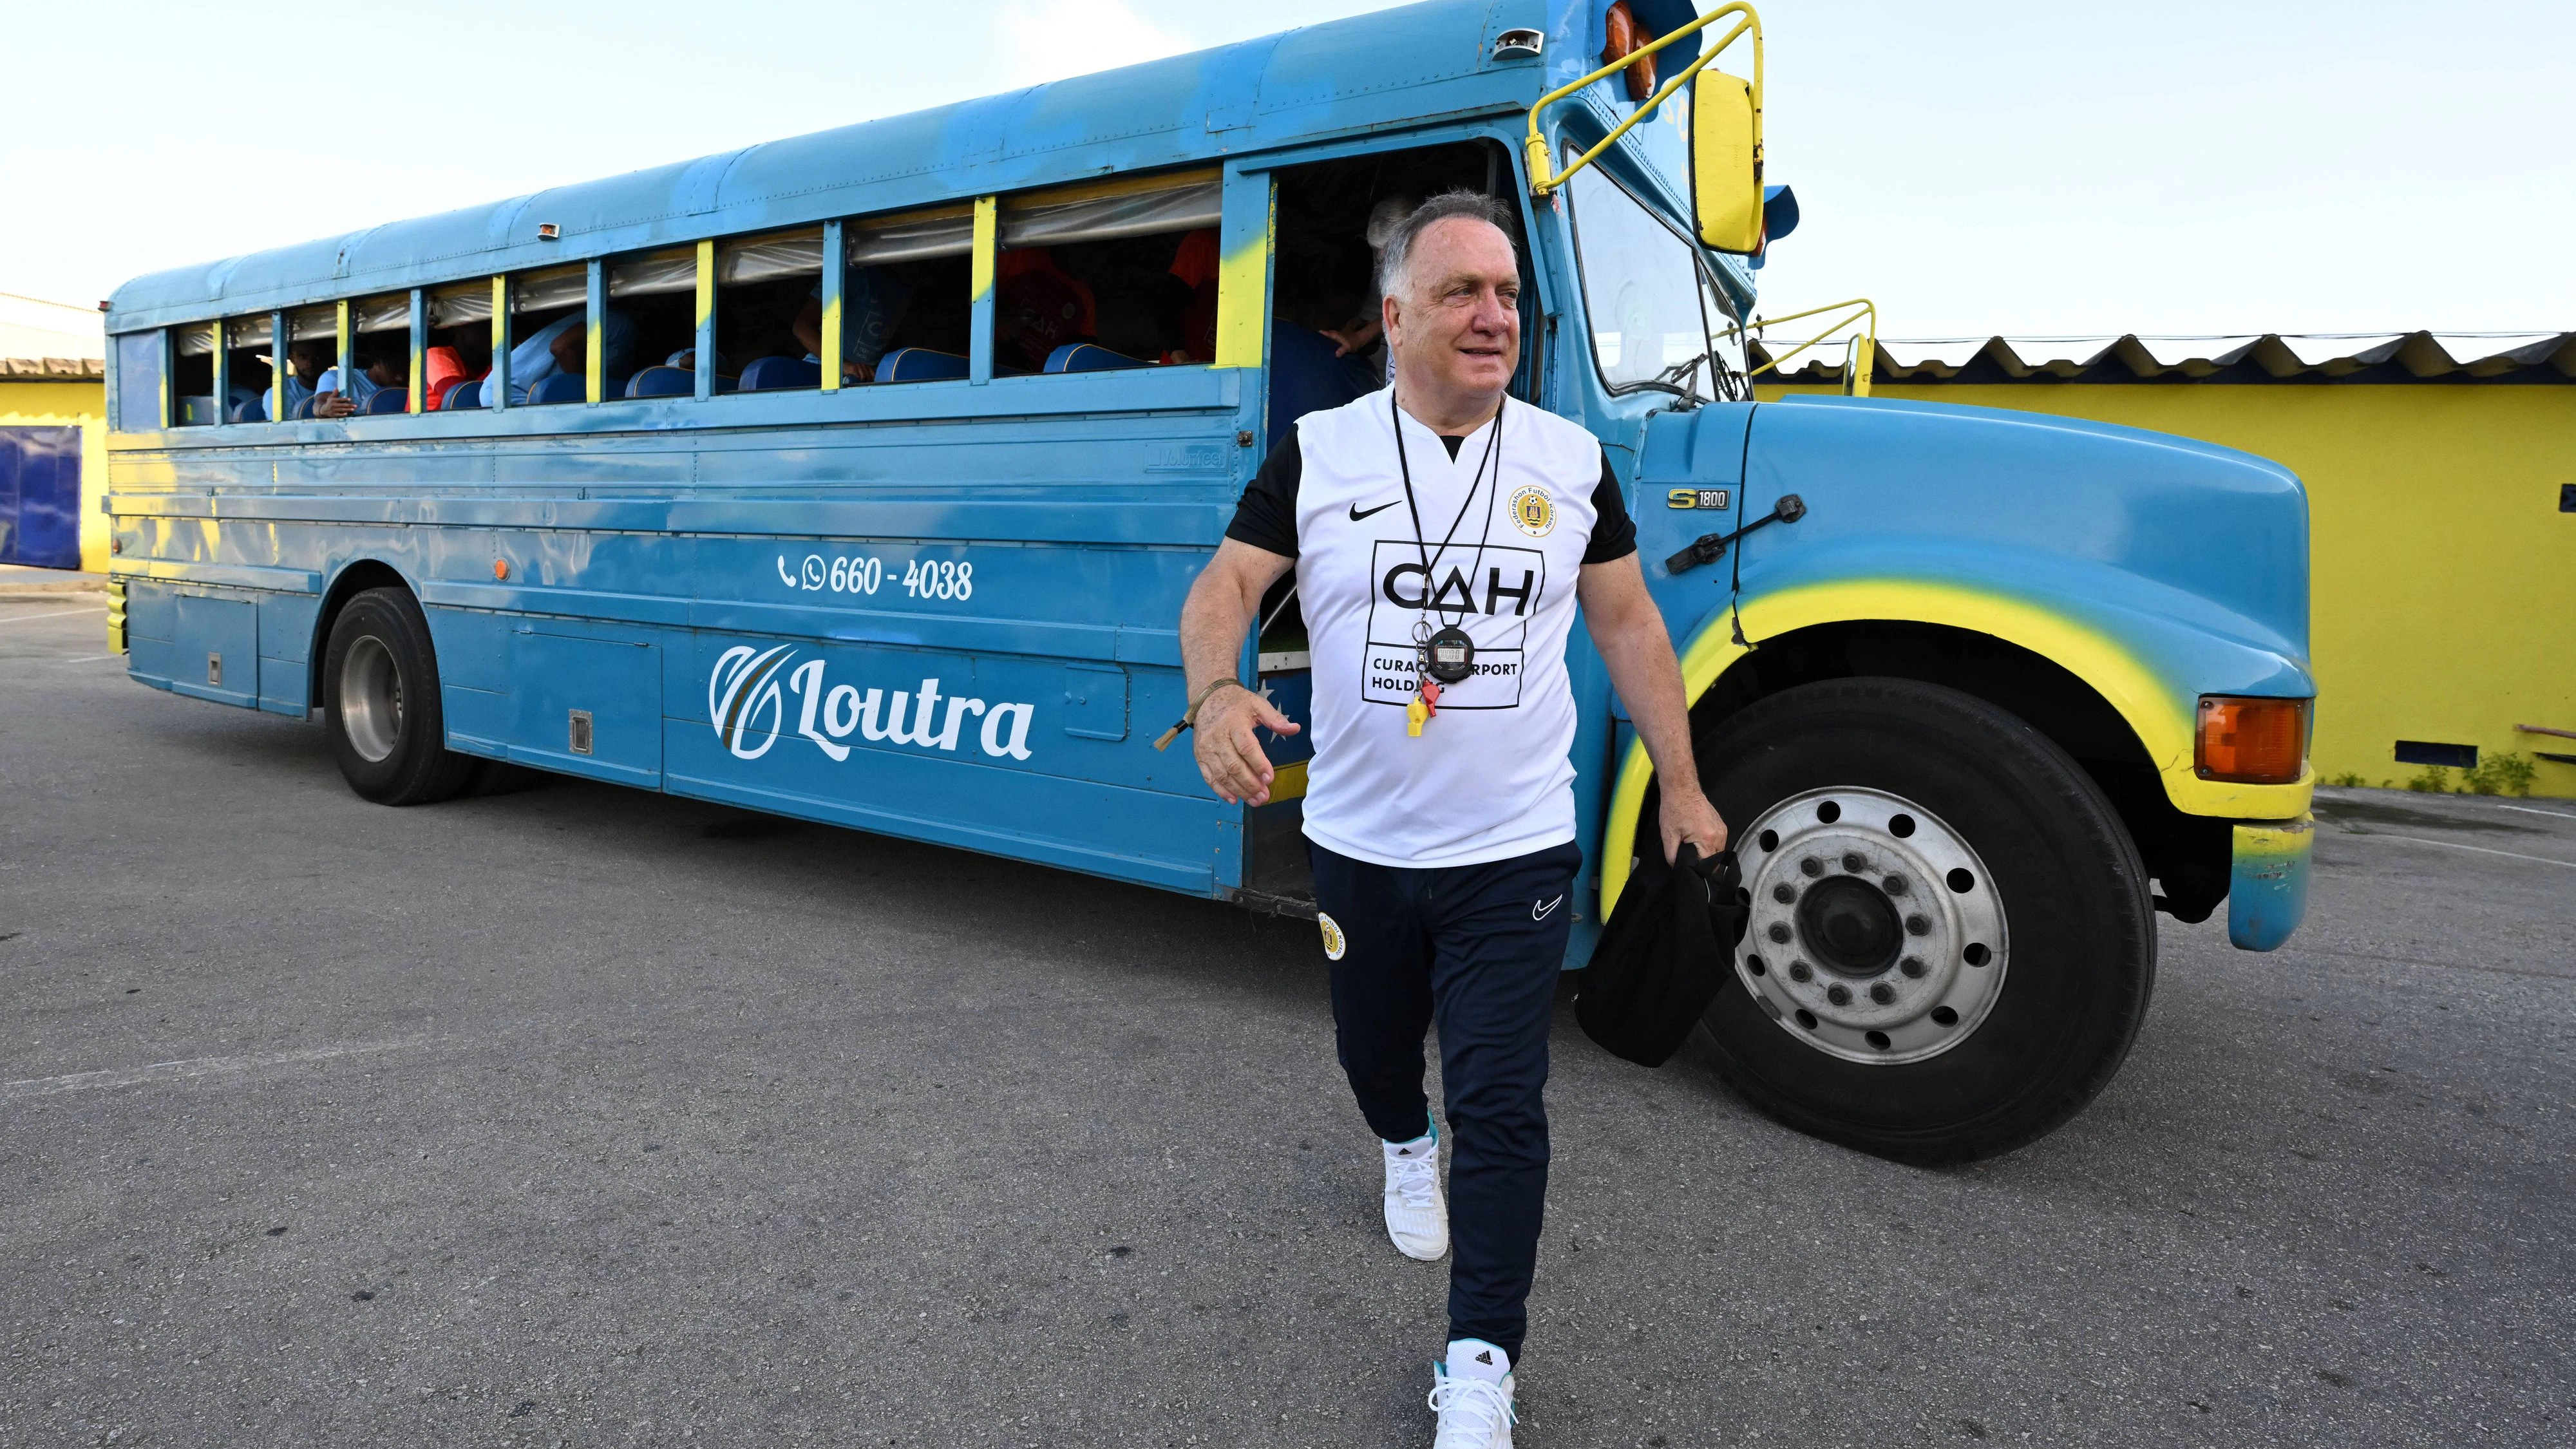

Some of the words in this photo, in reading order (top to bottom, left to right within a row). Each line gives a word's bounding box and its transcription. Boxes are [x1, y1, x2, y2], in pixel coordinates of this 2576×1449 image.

[1511, 489, 1527, 529] Federashon
[1699, 491, 1725, 506] 1800
[829, 556, 881, 595] 660
[902, 559, 973, 601] 4038
[1374, 658, 1429, 674] CURA
[1470, 664, 1517, 675] RPORT
[790, 659, 1034, 762] Loutra
[1475, 1356, 1493, 1365] adidas
